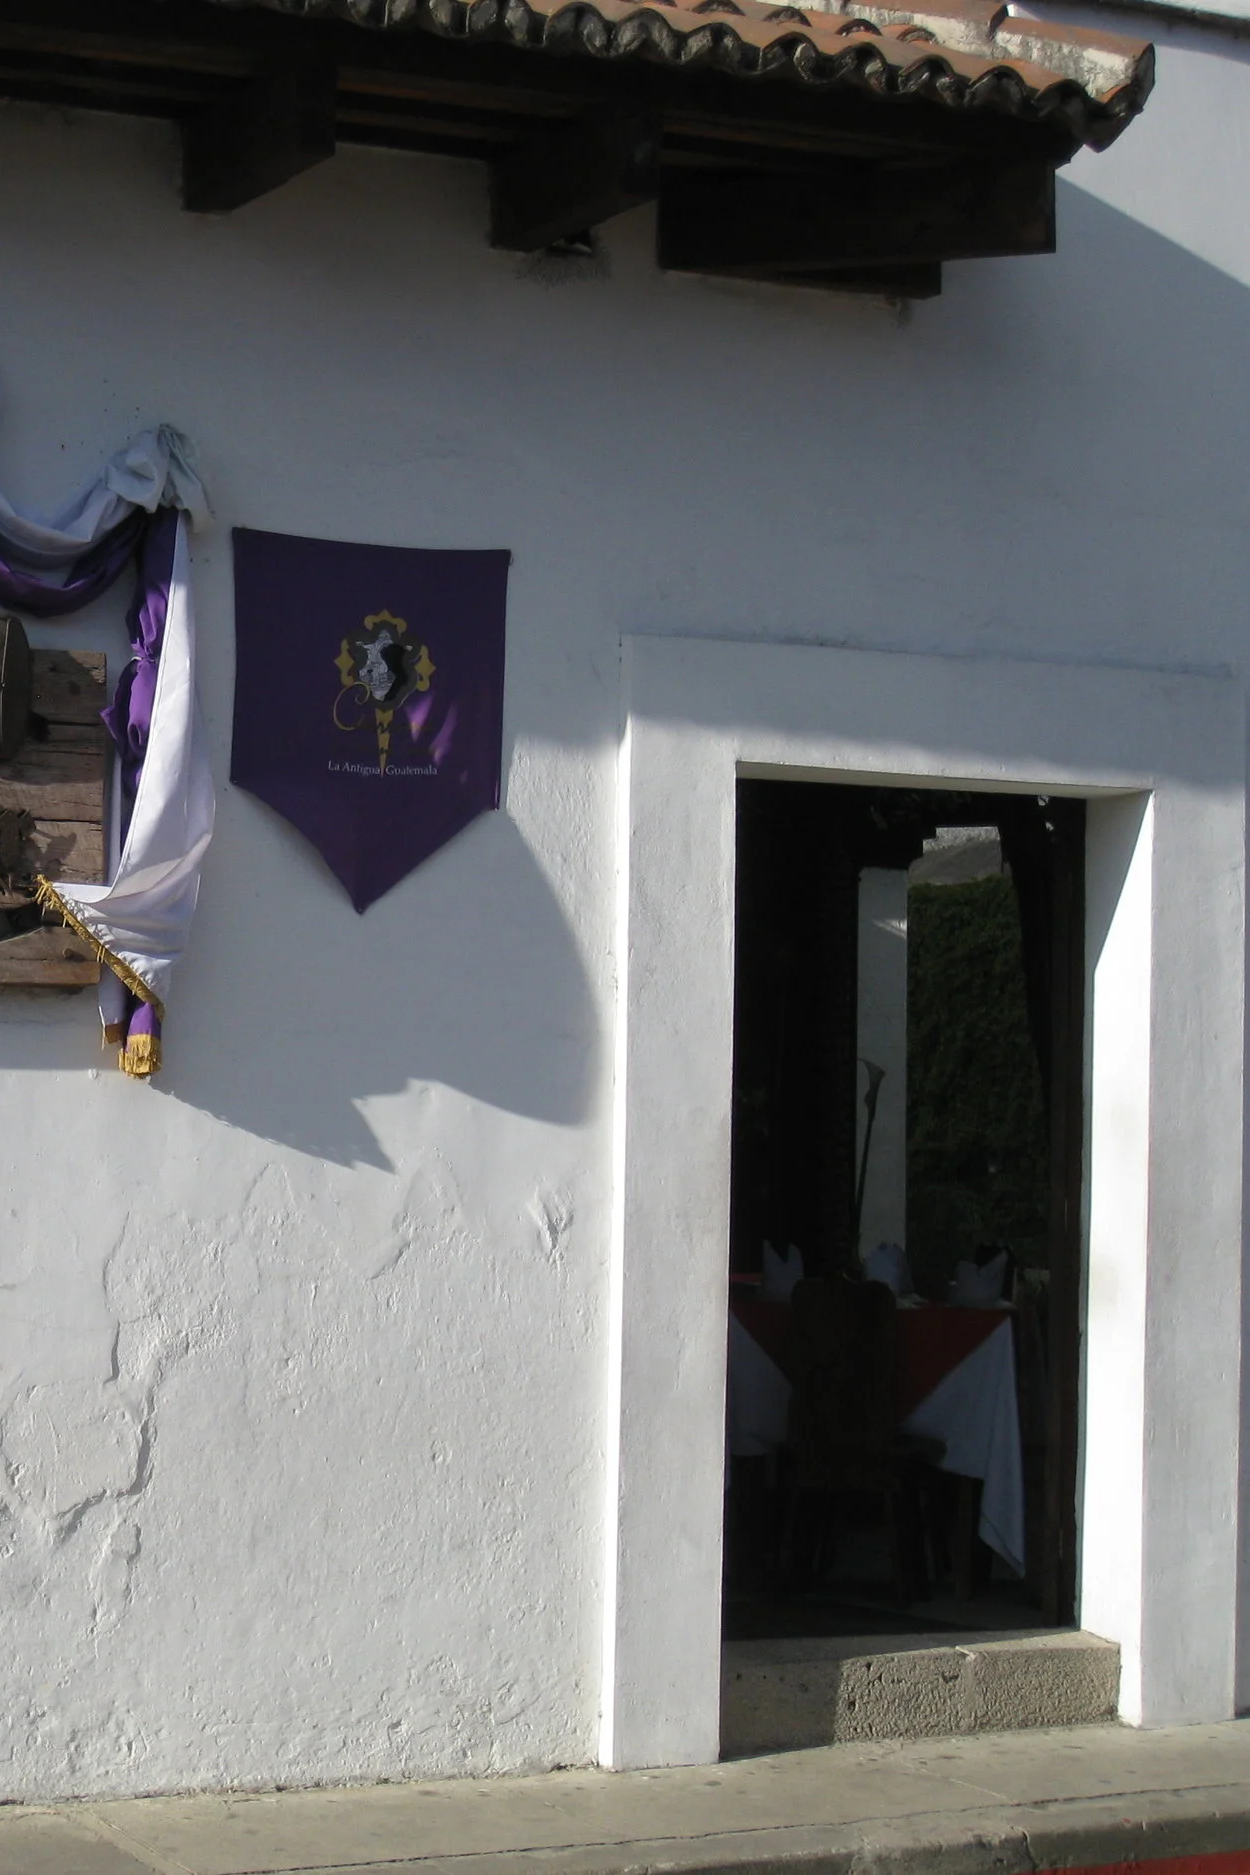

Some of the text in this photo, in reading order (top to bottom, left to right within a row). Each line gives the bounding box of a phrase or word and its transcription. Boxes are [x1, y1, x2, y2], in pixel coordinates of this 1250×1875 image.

[327, 760, 438, 776] La Antigua Guatemala
